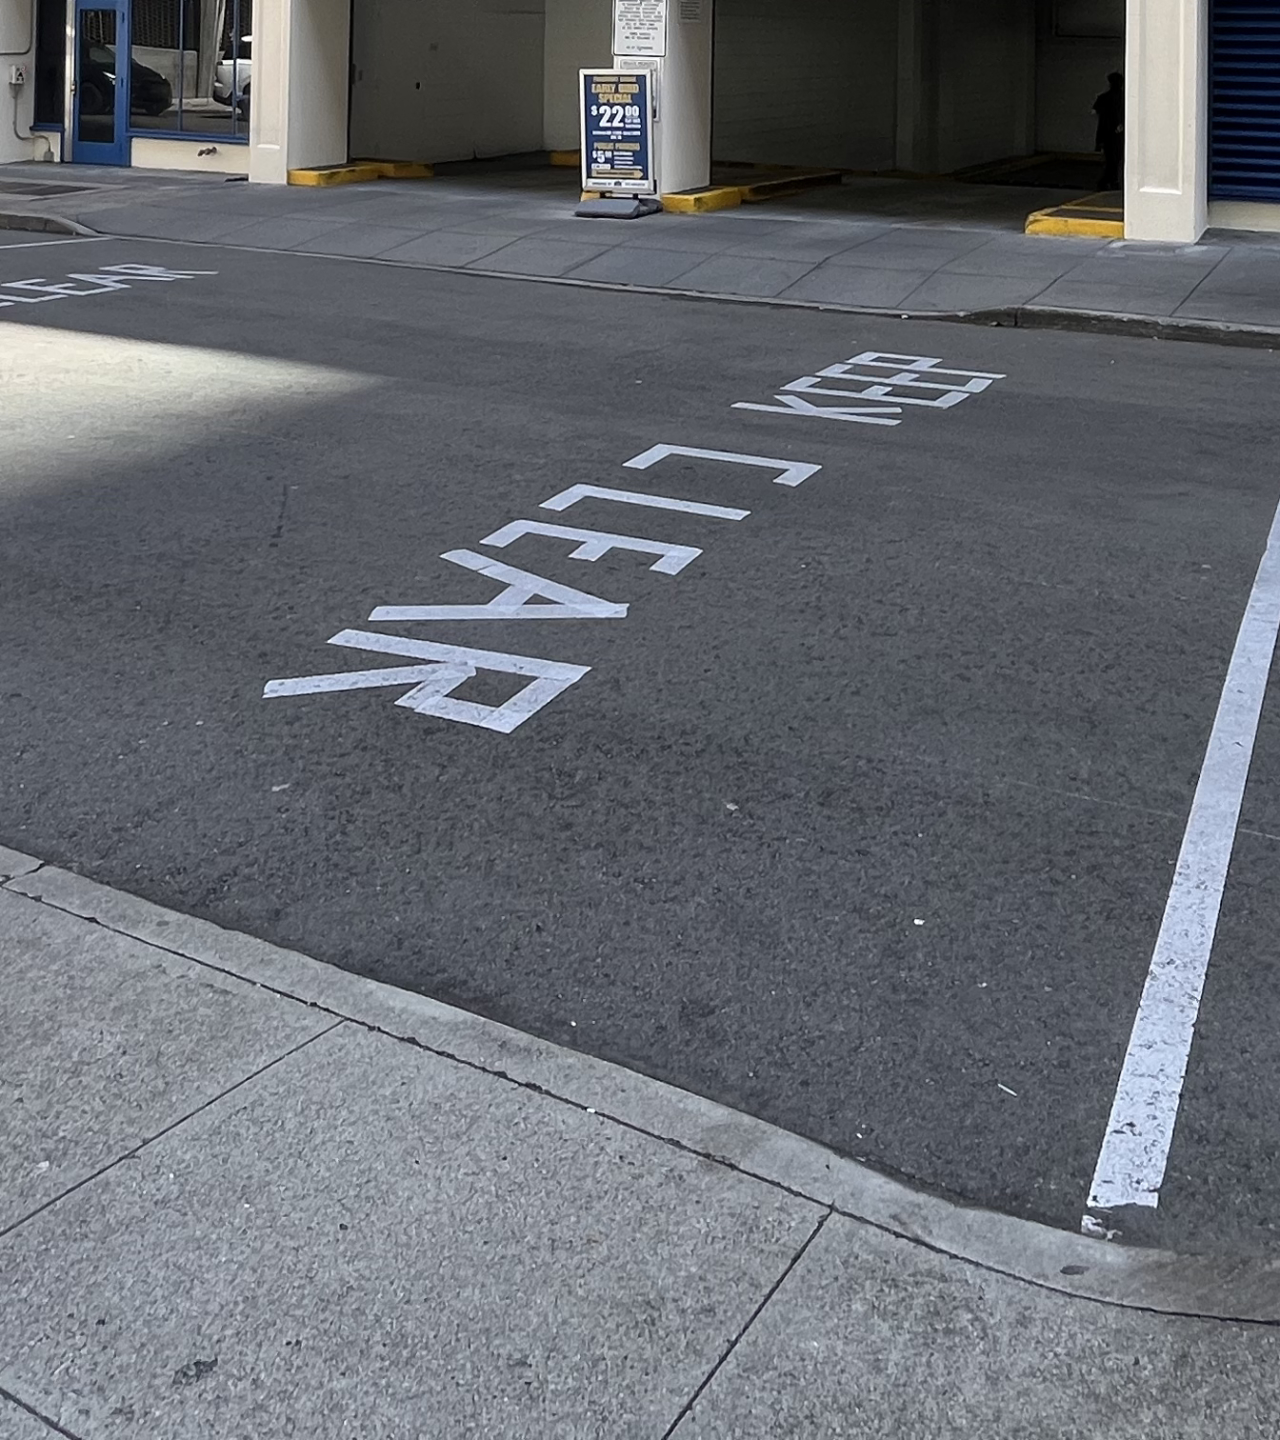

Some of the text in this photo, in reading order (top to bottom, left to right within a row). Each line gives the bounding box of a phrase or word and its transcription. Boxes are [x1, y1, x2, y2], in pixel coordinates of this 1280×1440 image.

[598, 93, 632, 103] SPECIAL
[731, 351, 1007, 426] KEEP
[262, 443, 823, 734] CLEAR
